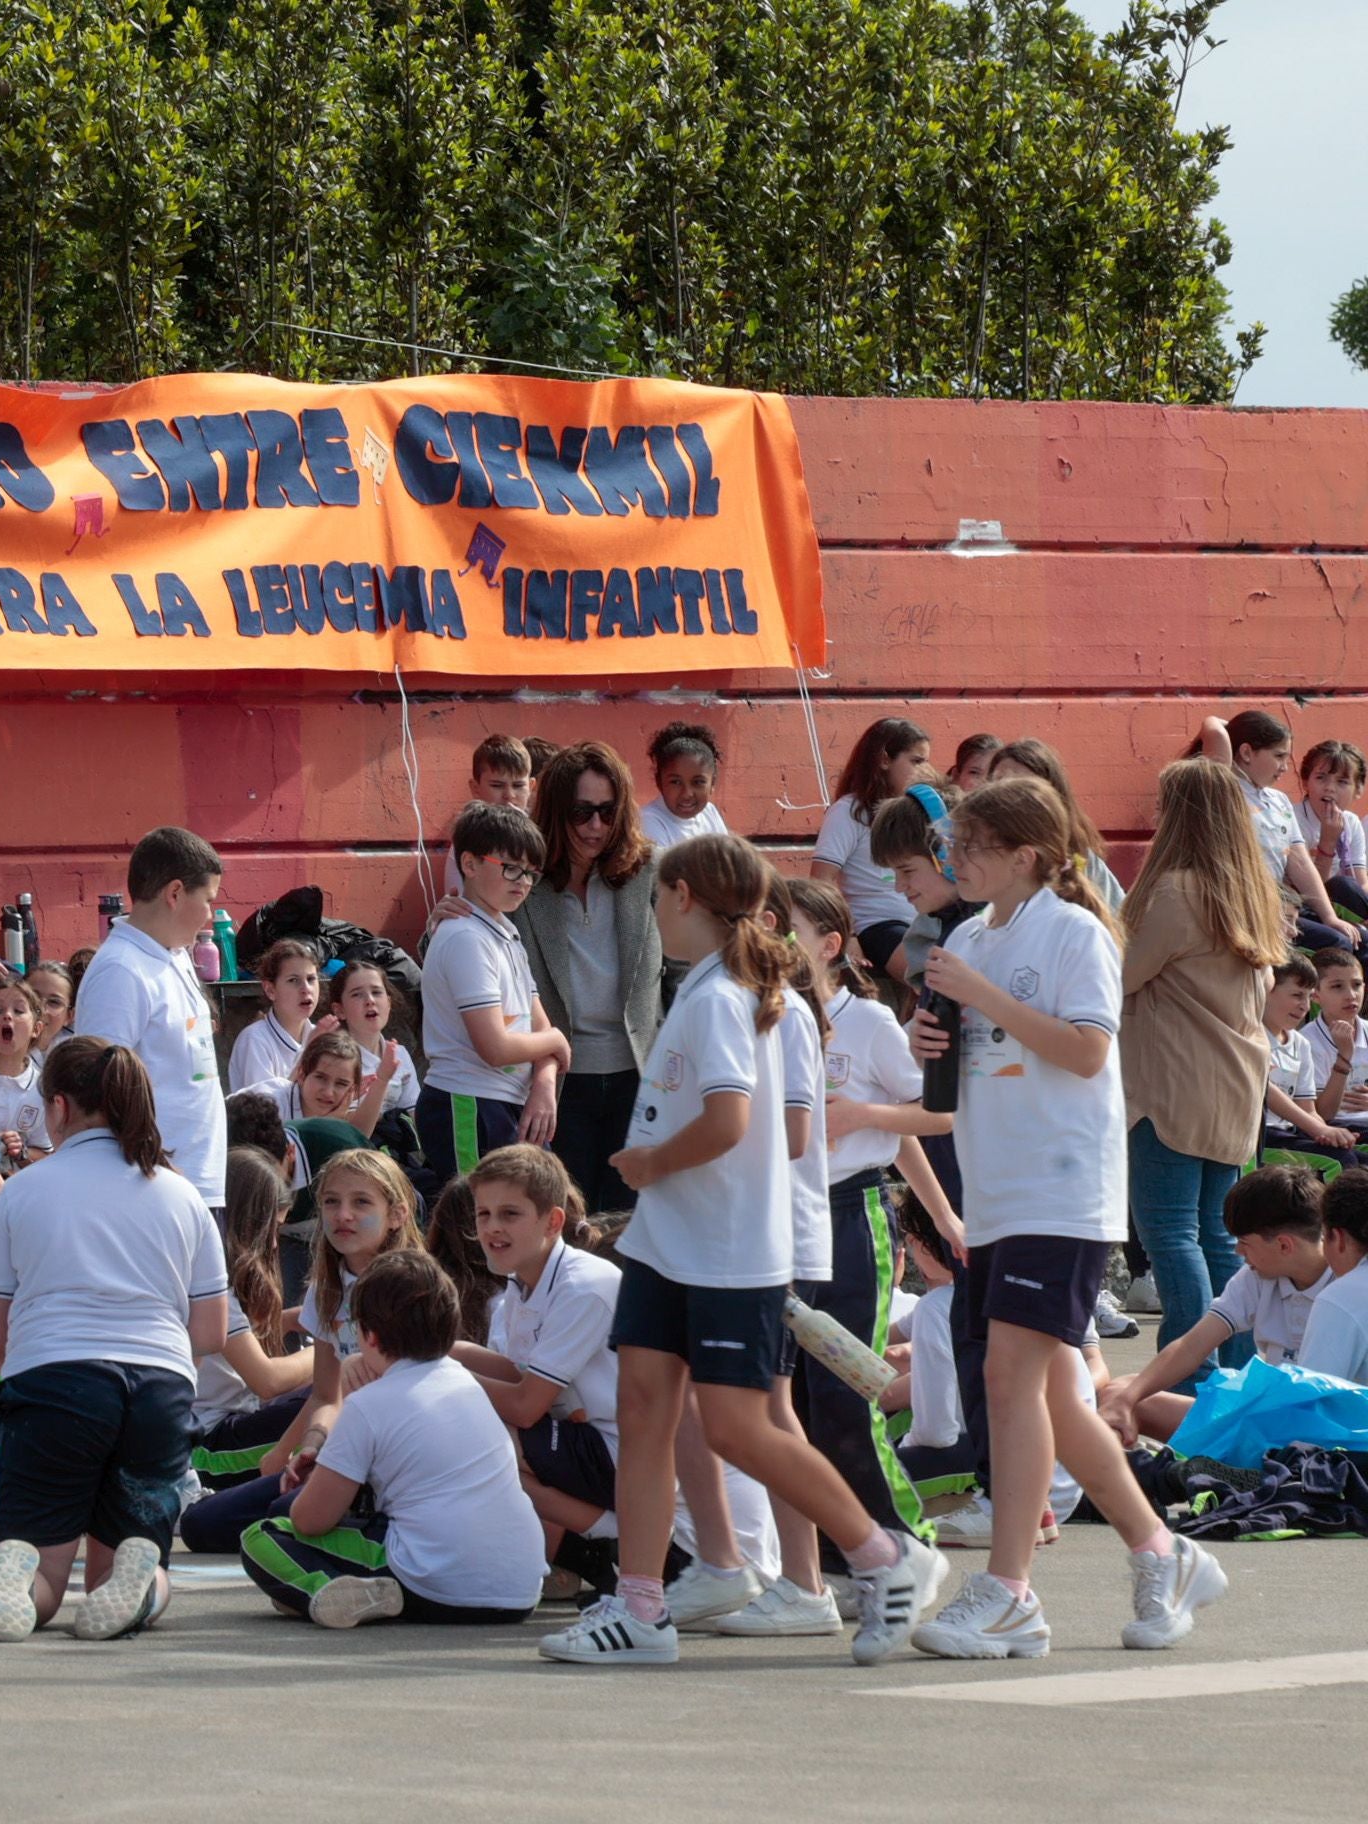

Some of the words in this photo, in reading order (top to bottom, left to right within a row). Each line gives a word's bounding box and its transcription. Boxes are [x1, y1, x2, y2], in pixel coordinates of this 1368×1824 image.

[81, 408, 360, 511] ENTRE
[112, 572, 211, 637] LA
[503, 566, 757, 641] INFANTIL
